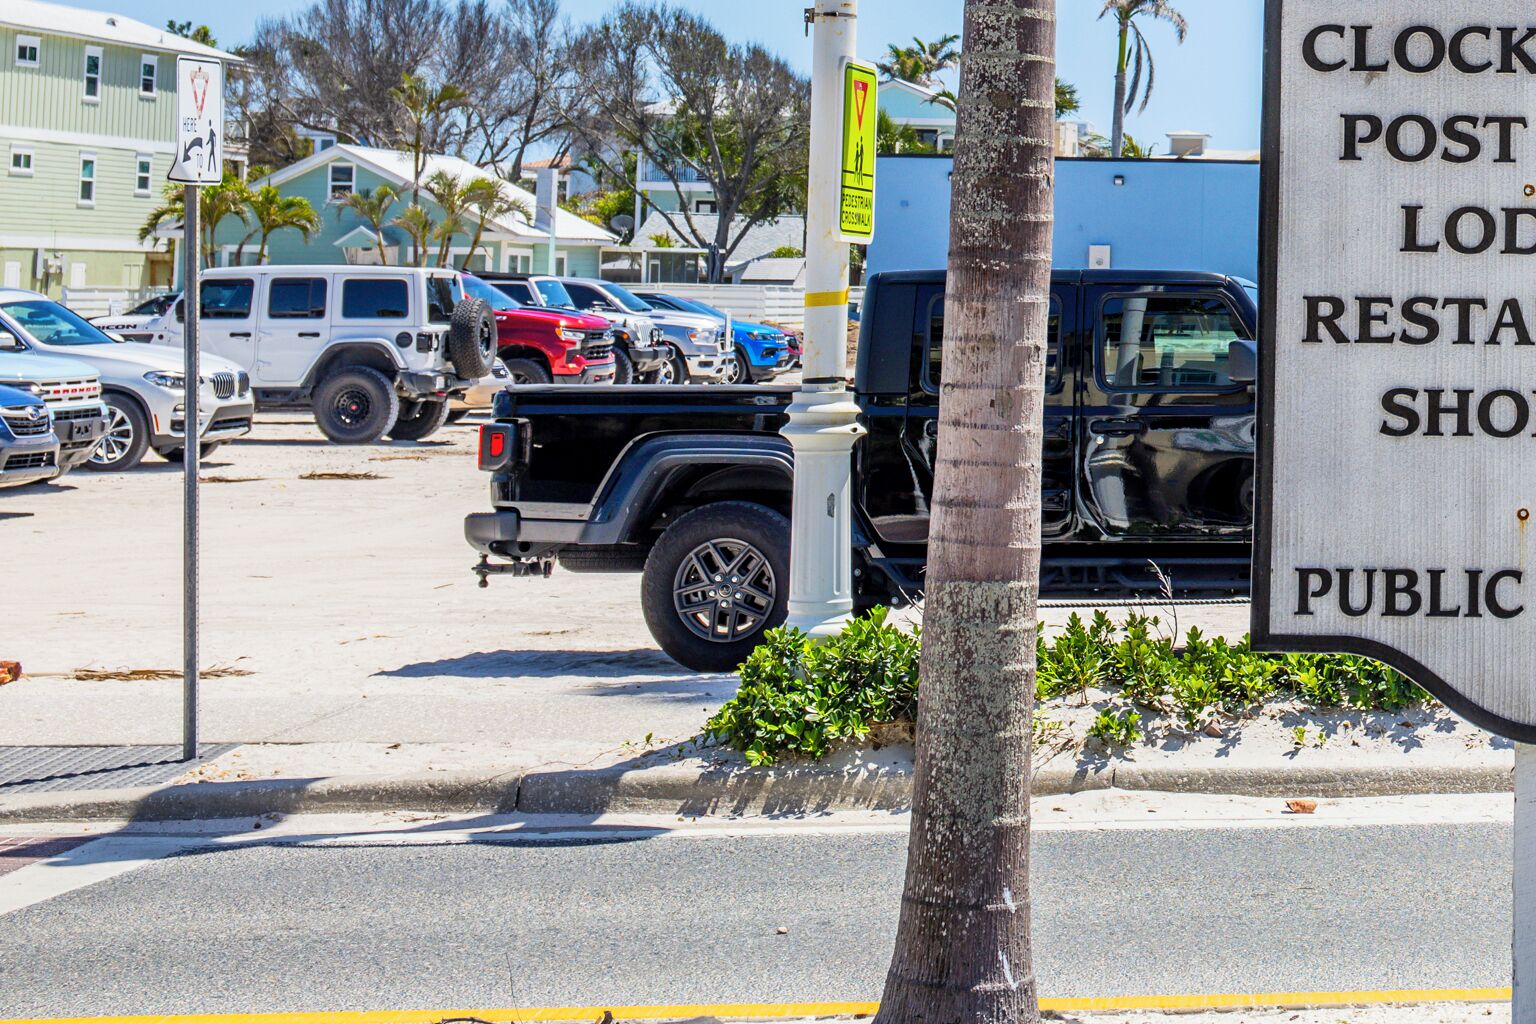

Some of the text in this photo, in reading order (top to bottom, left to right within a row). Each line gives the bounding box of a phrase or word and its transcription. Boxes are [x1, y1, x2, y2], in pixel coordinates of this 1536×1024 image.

[183, 117, 197, 132] HERE
[1339, 113, 1527, 163] POST
[842, 193, 872, 209] PEDESTRIAN
[842, 210, 871, 227] CROSSWALK
[1294, 566, 1525, 619] PUBLIC
